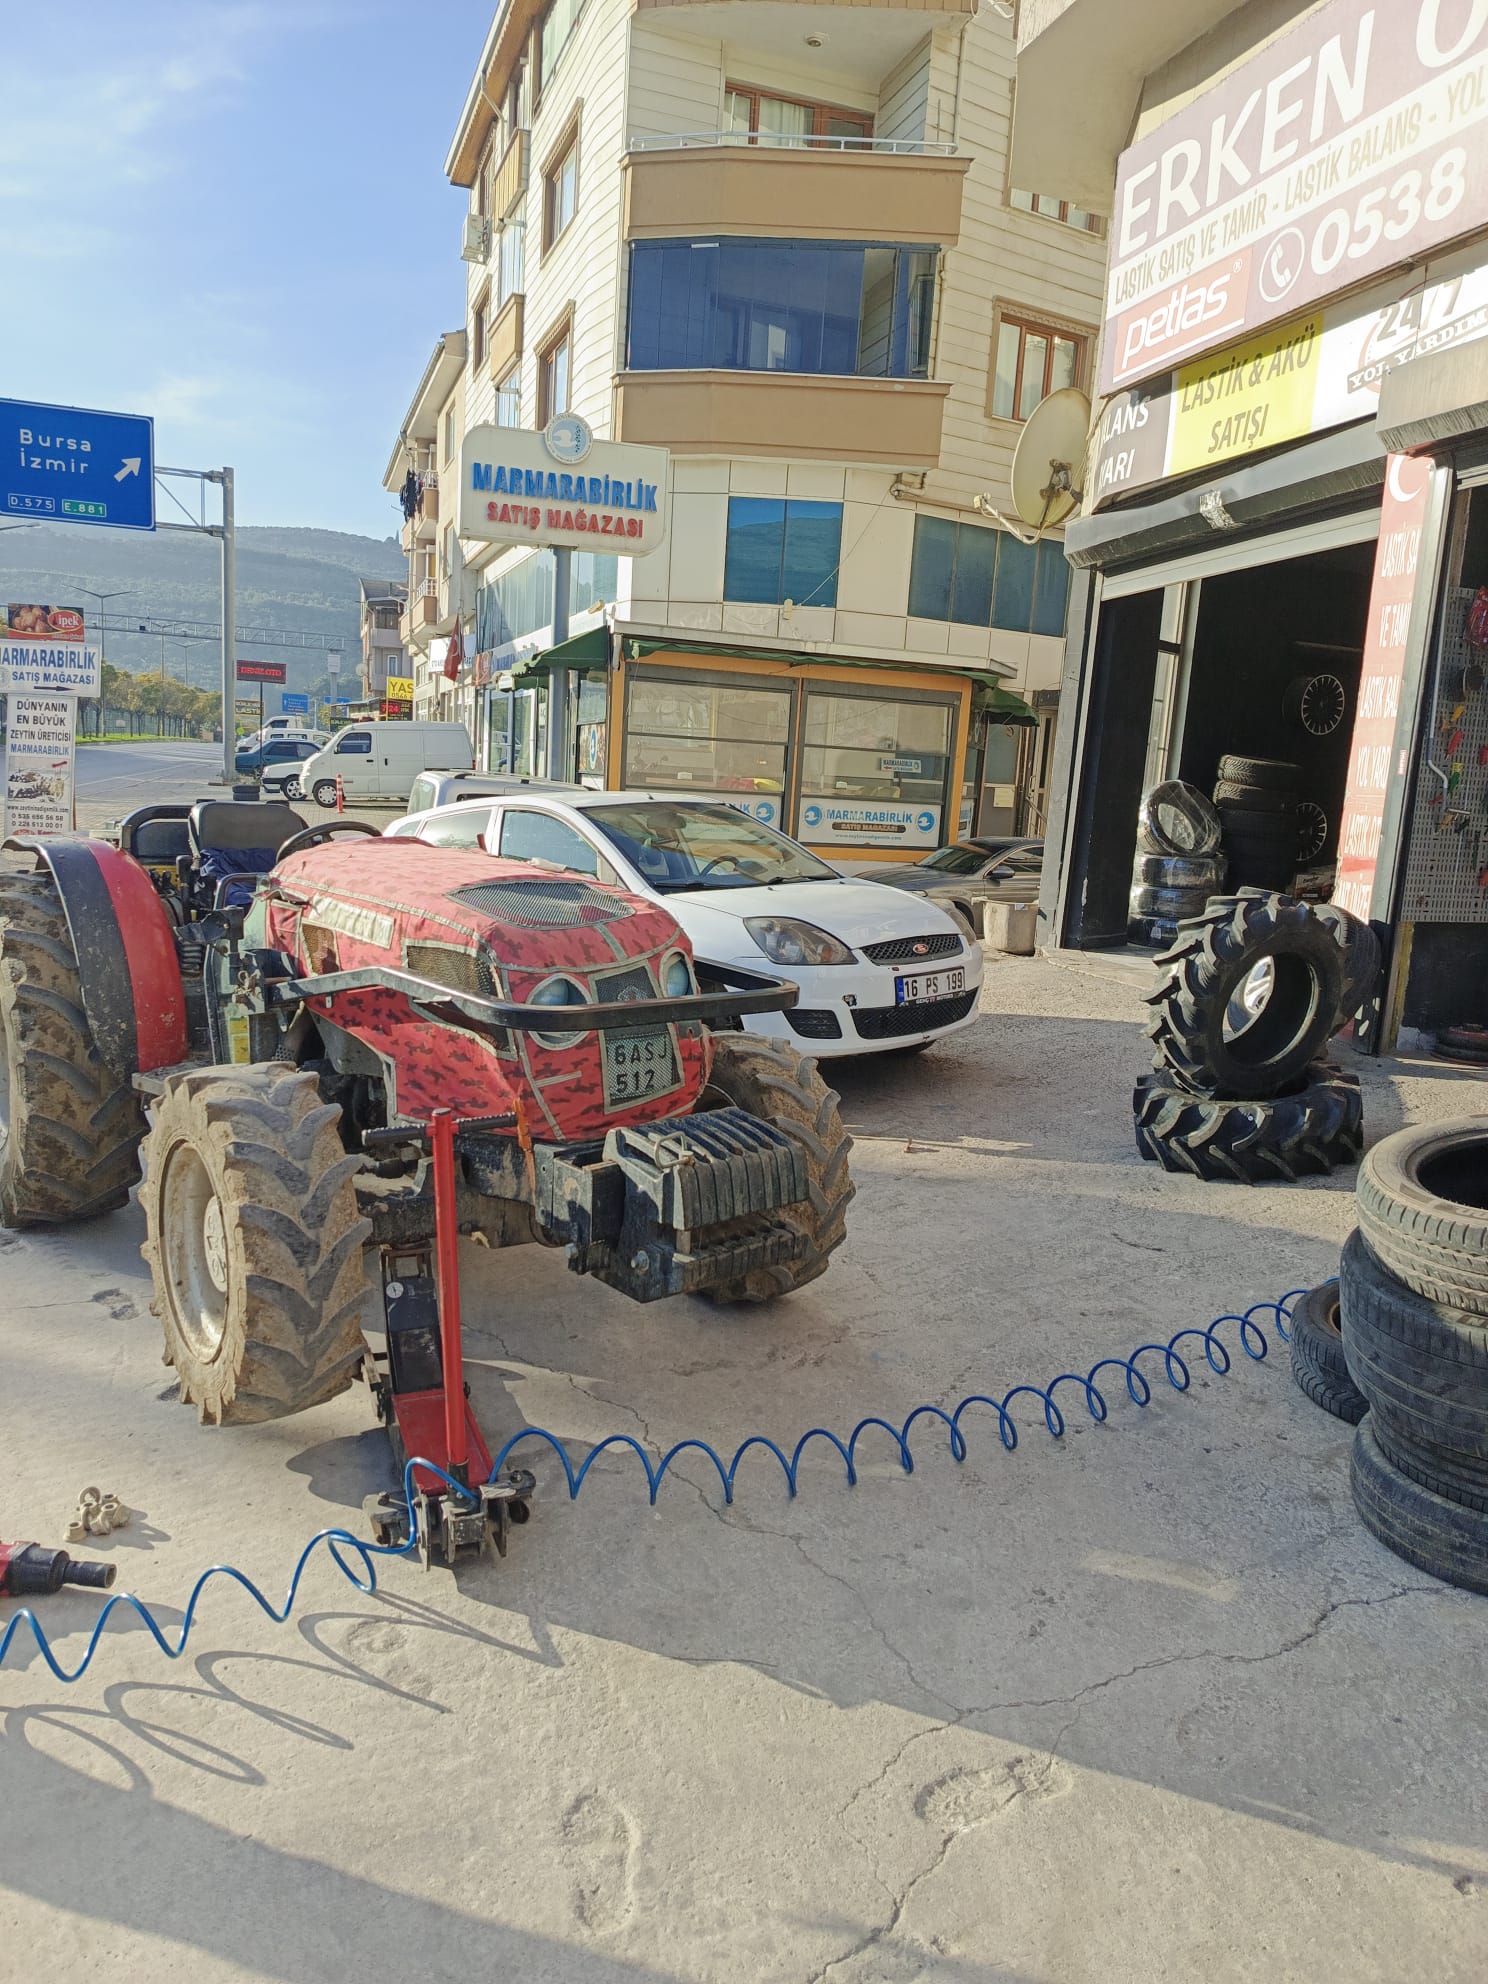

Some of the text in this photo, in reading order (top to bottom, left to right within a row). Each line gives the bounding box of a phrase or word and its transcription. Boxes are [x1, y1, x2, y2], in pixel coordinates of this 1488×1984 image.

[1118, 8, 1375, 260] ERKEN
[1115, 253, 1156, 305] LASTİK
[1159, 231, 1196, 283] SATIŞ
[1201, 219, 1217, 259] VE
[1222, 189, 1268, 249] TAMİR
[1284, 144, 1344, 213] LASTİK
[1348, 101, 1422, 178] BALANS
[1310, 147, 1467, 276] 0538
[1121, 273, 1231, 370] petlas
[1181, 322, 1315, 413] LASTİK & AKÜ
[1102, 396, 1151, 444] LANS
[1208, 404, 1269, 453] SATIŞI
[20, 428, 92, 452] Bursa
[20, 447, 89, 474] İzmir
[472, 462, 658, 513] MARMARABİRLİK
[10, 496, 104, 515] D.575 E.881
[487, 501, 644, 538] SATIŞ MAĞAZASI
[58, 614, 80, 628] ipek
[0, 645, 96, 670] ARMARABİRLİK
[12, 671, 95, 685] SATIŞ MAĞAZASI
[17, 698, 68, 712] DÜNYANIN
[17, 713, 66, 727] EN BÜYÜK
[10, 728, 35, 740] ZEYTİN
[826, 808, 913, 824] MARMARABİRLİK
[904, 972, 963, 998] 16 PS 199
[616, 1069, 655, 1093] 512
